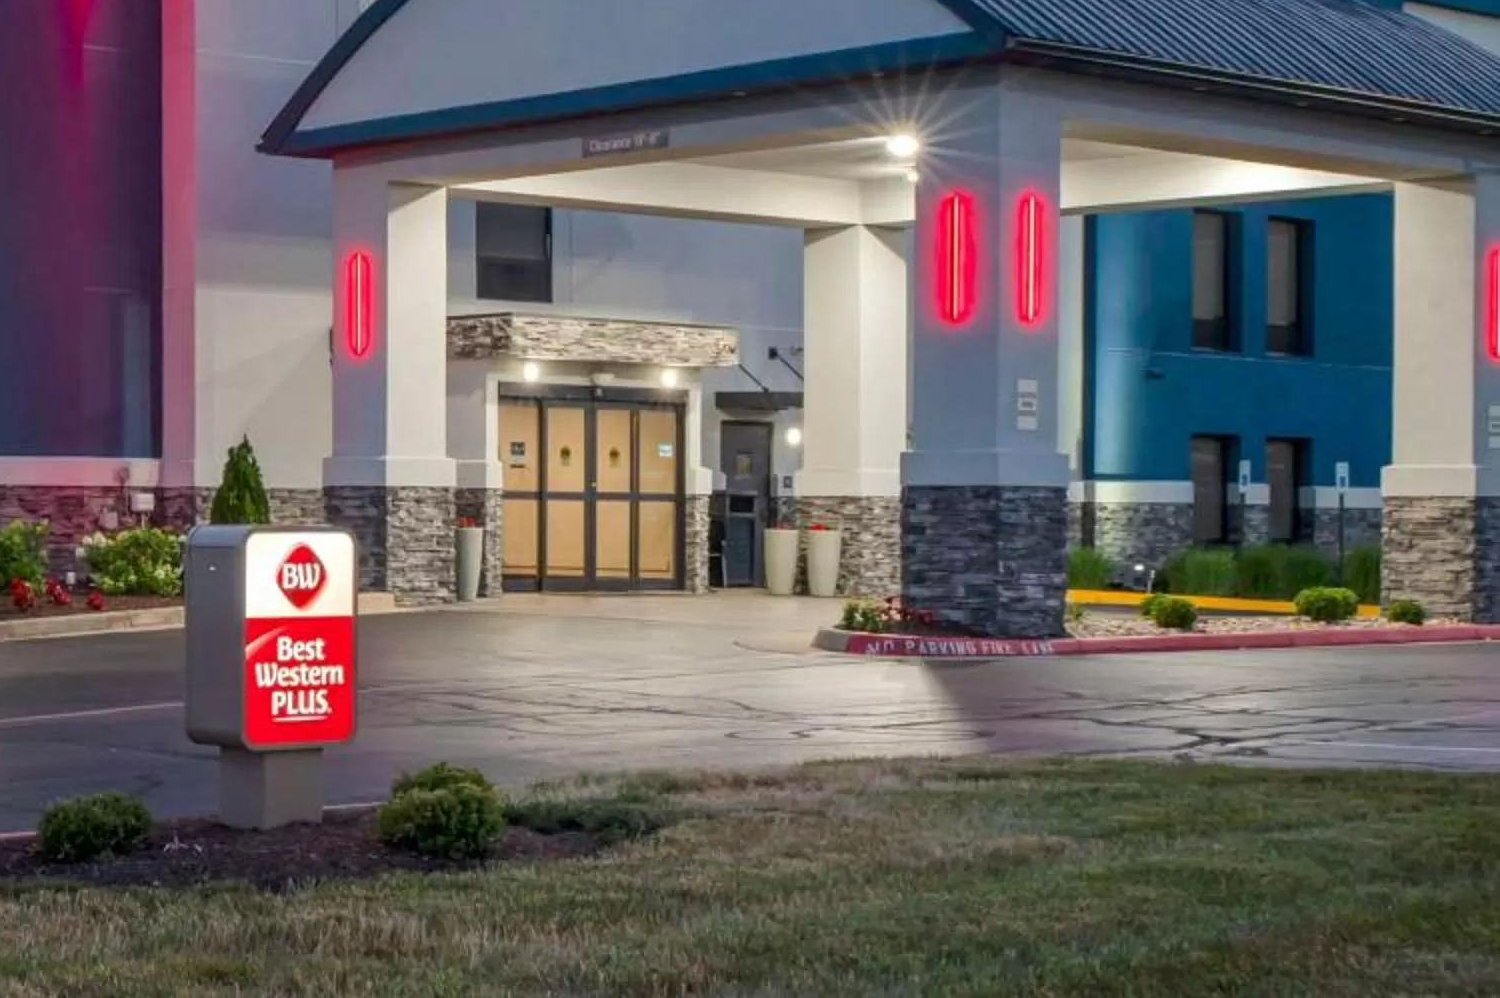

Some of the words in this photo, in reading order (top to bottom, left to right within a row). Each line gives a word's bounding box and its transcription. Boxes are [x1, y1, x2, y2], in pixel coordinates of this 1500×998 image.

[282, 562, 321, 590] BW
[276, 636, 326, 661] Best
[255, 662, 344, 688] Western
